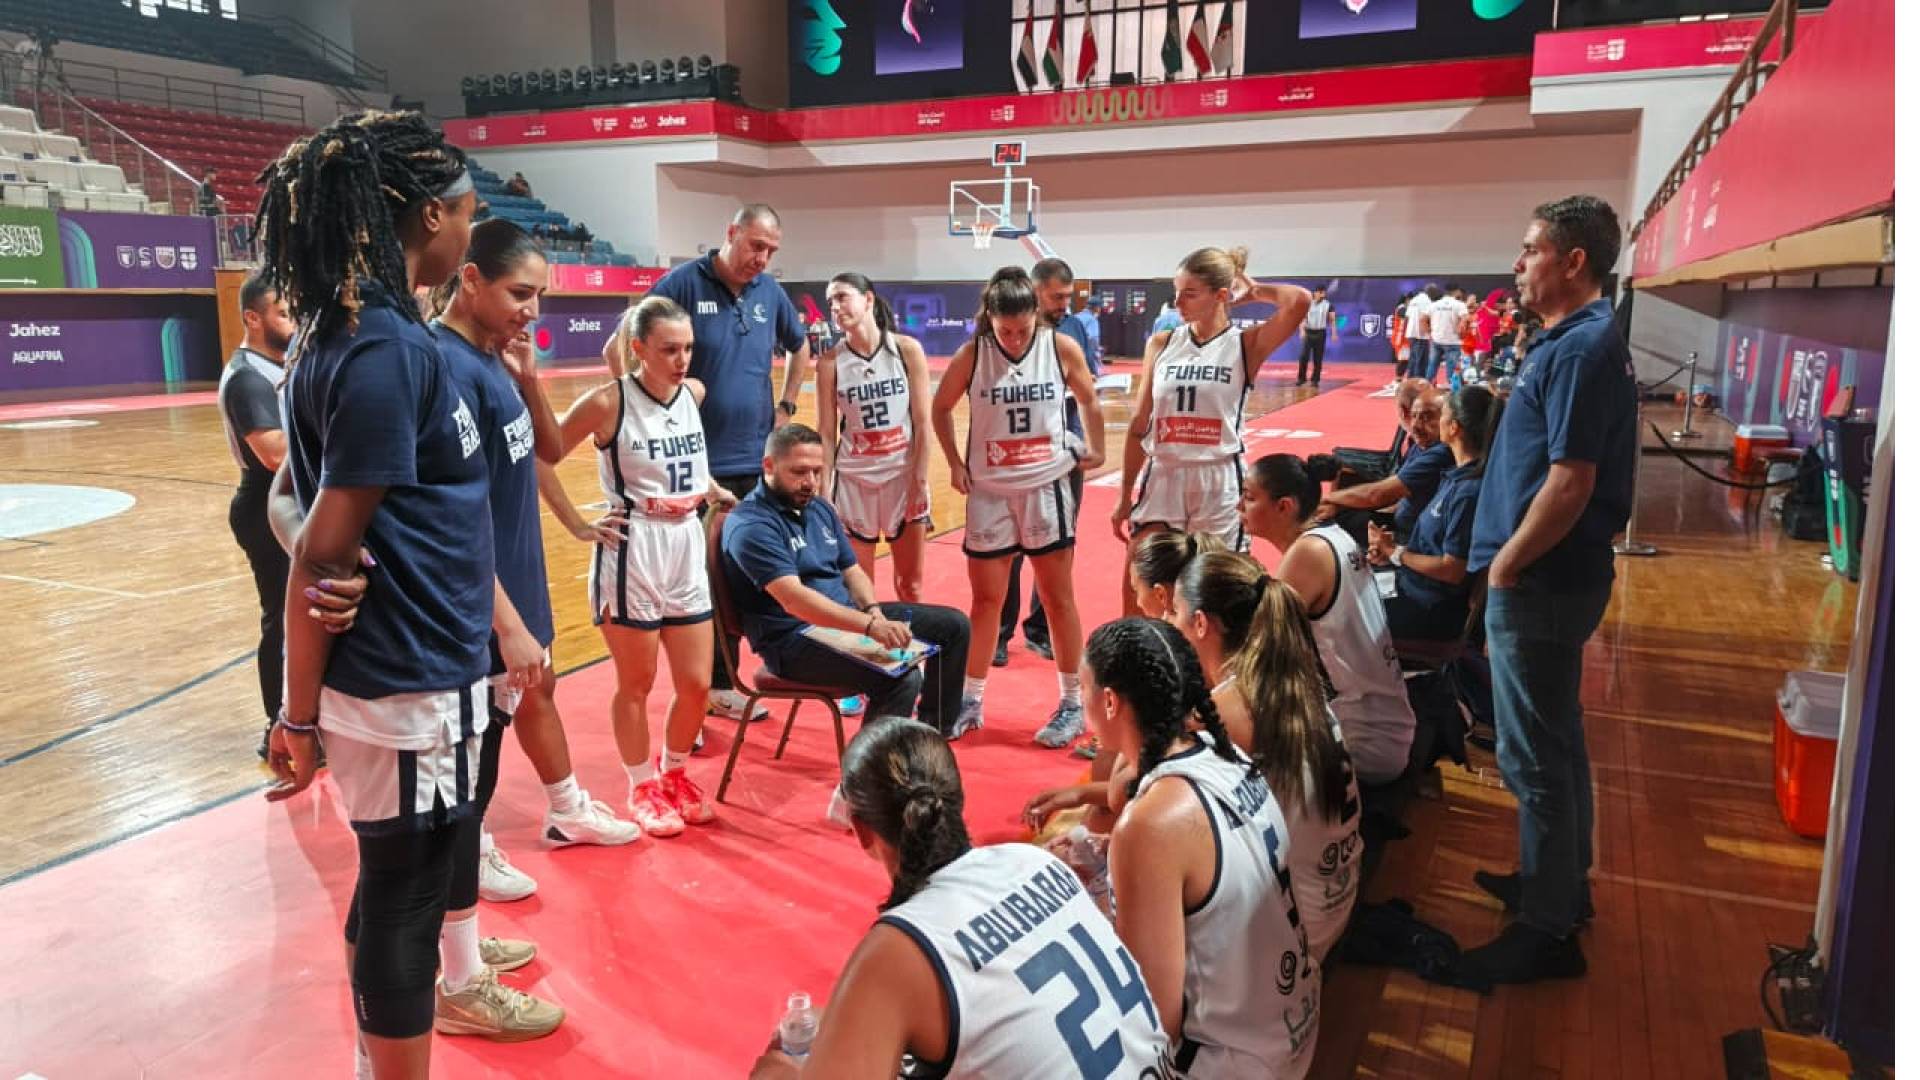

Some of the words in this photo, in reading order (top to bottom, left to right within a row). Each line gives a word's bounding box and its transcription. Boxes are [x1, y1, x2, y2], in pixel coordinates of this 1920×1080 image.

[997, 144, 1020, 163] 24
[9, 323, 61, 337] Jahez
[568, 319, 601, 333] Jahez
[1164, 364, 1233, 385] FUHEIS
[846, 377, 906, 404] FUHEIS
[991, 382, 1055, 406] FUHEIS
[1175, 385, 1197, 412] 11
[860, 401, 890, 430] 22
[1006, 407, 1031, 434] 13
[666, 461, 693, 493] 12
[1014, 921, 1158, 1080] 24
